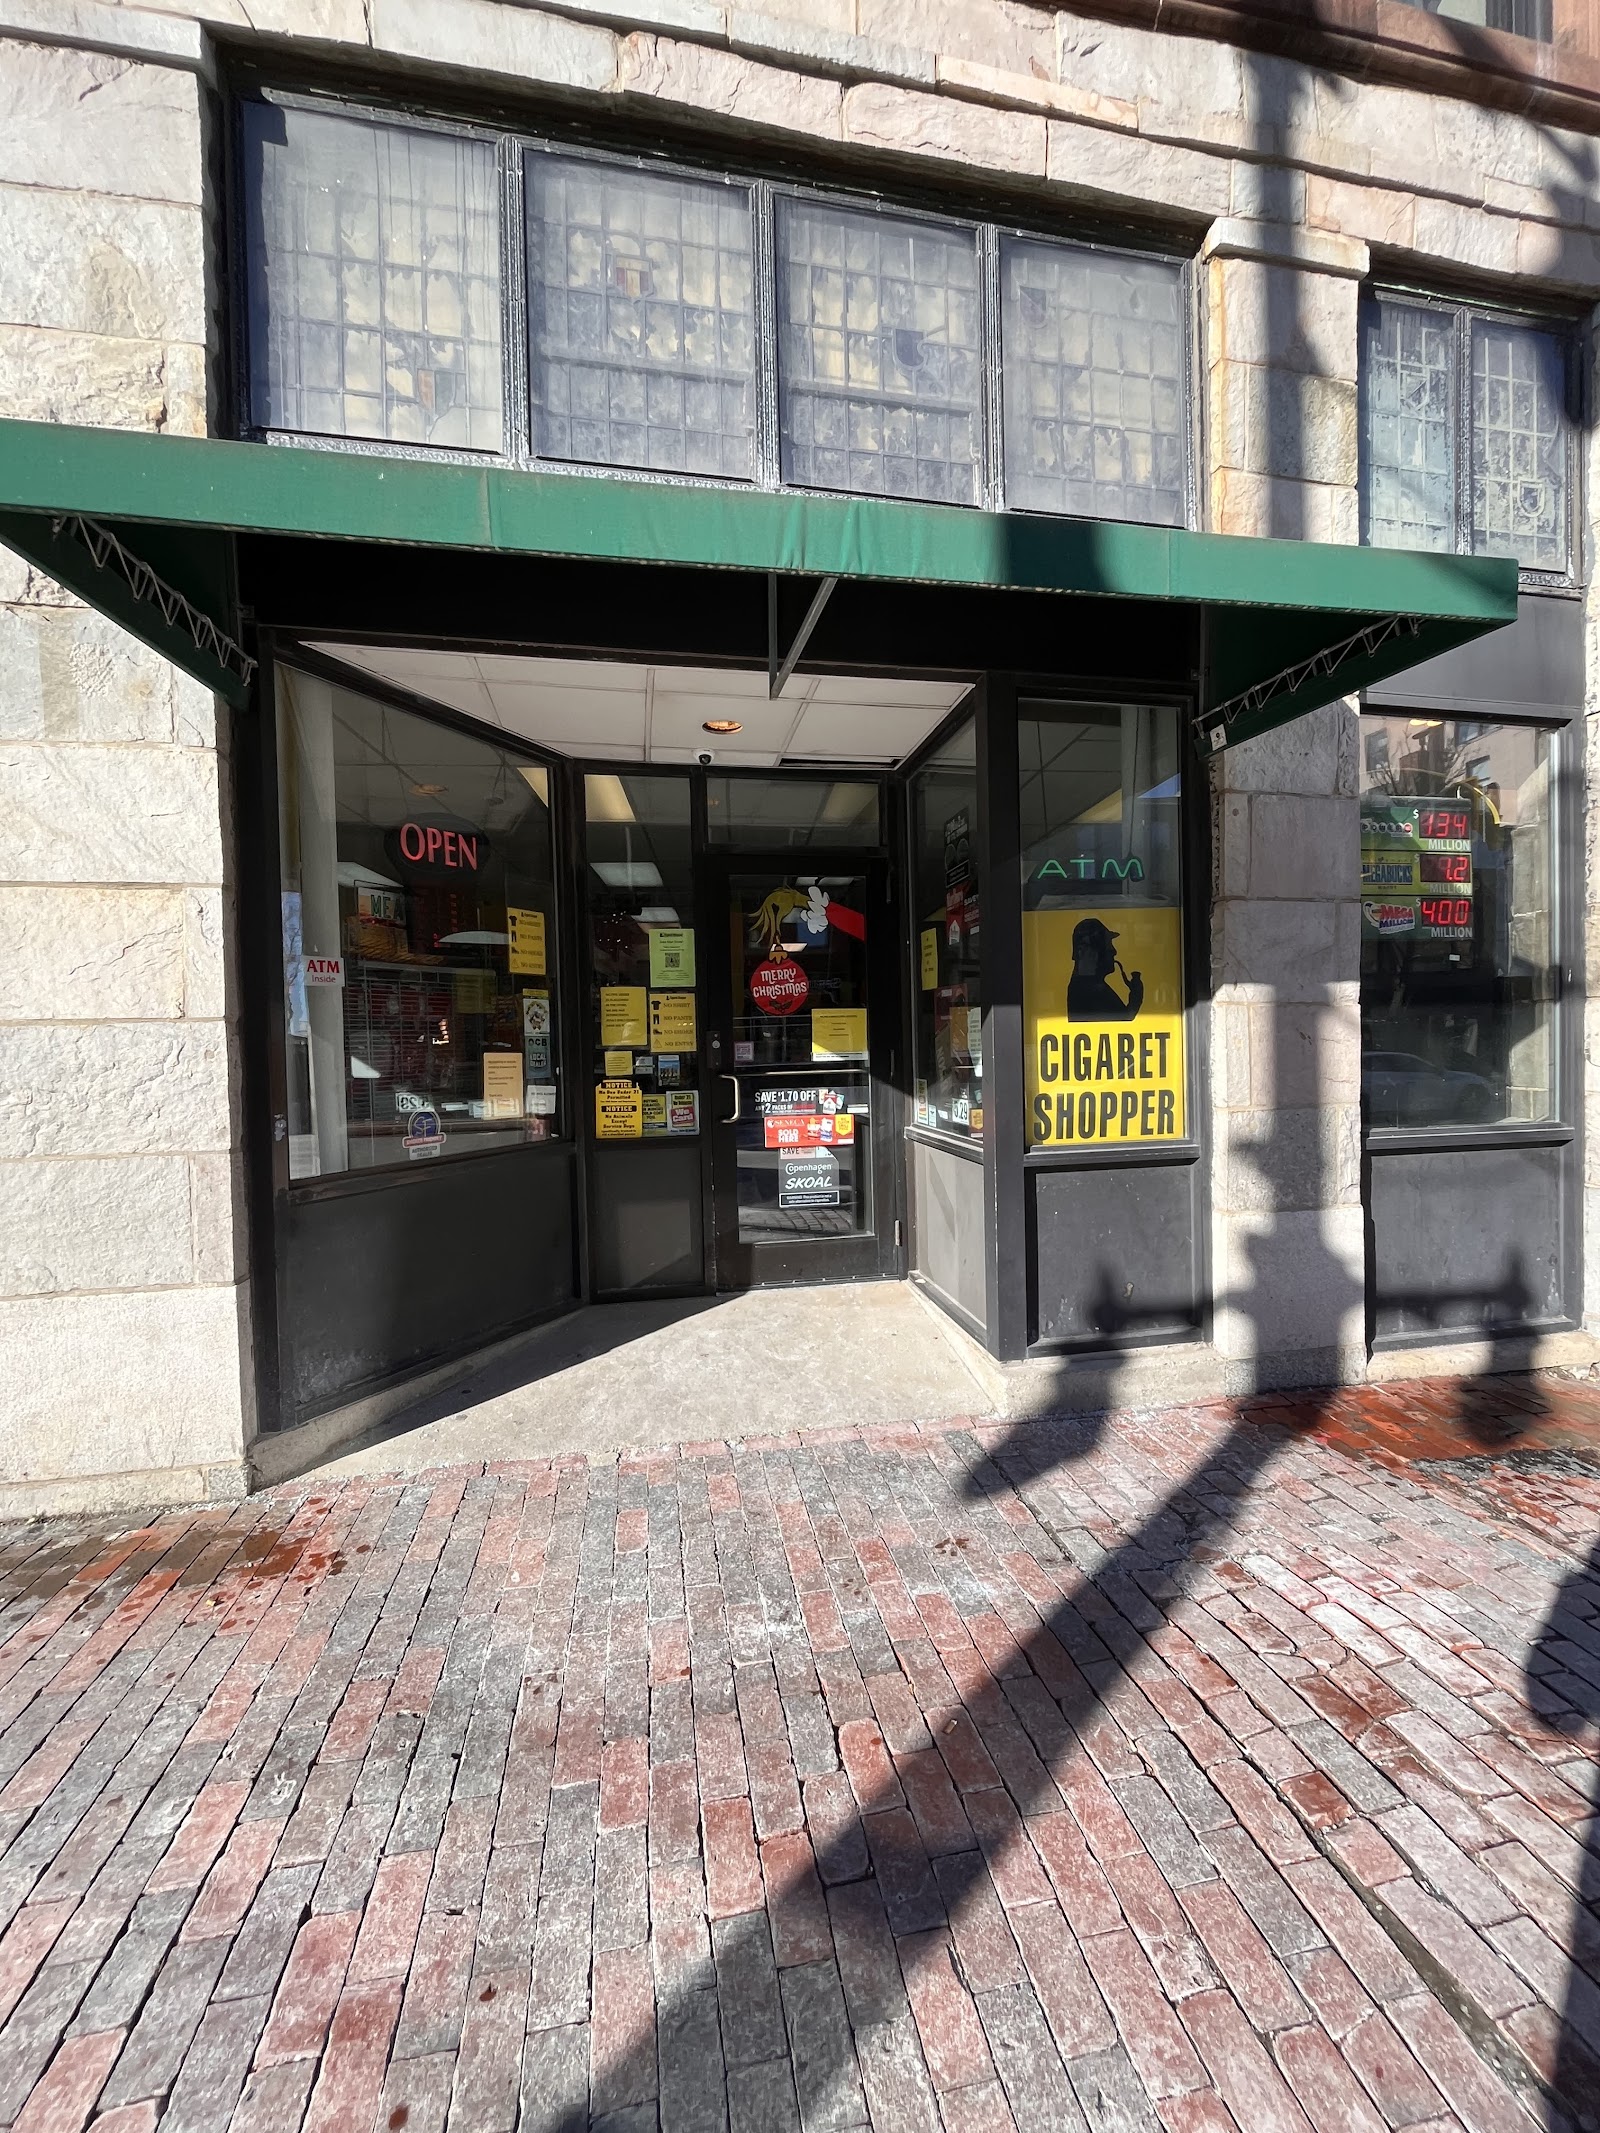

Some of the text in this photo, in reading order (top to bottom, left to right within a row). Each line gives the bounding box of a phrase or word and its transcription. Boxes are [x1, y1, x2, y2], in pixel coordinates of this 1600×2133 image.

[1413, 809, 1467, 837] $ 134
[400, 823, 477, 870] OPEN
[1428, 840, 1470, 850] MILLION
[1036, 858, 1143, 880] ATM
[1414, 853, 1468, 880] $ 1.2
[1429, 883, 1471, 894] MILLION
[1380, 904, 1413, 919] MEGA
[1415, 898, 1469, 924] $ 400
[1431, 927, 1472, 937] MILLION
[306, 959, 340, 973] ATM
[312, 974, 336, 983] Inside
[760, 968, 796, 984] MERRY
[753, 982, 808, 999] CHRISTMAS
[528, 1038, 547, 1047] OCB
[529, 1053, 546, 1061] LOCAL
[1039, 1032, 1171, 1083] CIGARET
[755, 1091, 776, 1102] SAVE
[800, 1090, 816, 1101] OFF
[765, 1103, 771, 1113] 2
[953, 1101, 968, 1121] 5.29
[673, 1113, 693, 1122] Card
[1033, 1090, 1175, 1141] SHOPPER
[782, 1147, 800, 1155] SAVE
[785, 1163, 832, 1175] Copenhagen
[785, 1176, 832, 1189] SKOAL
